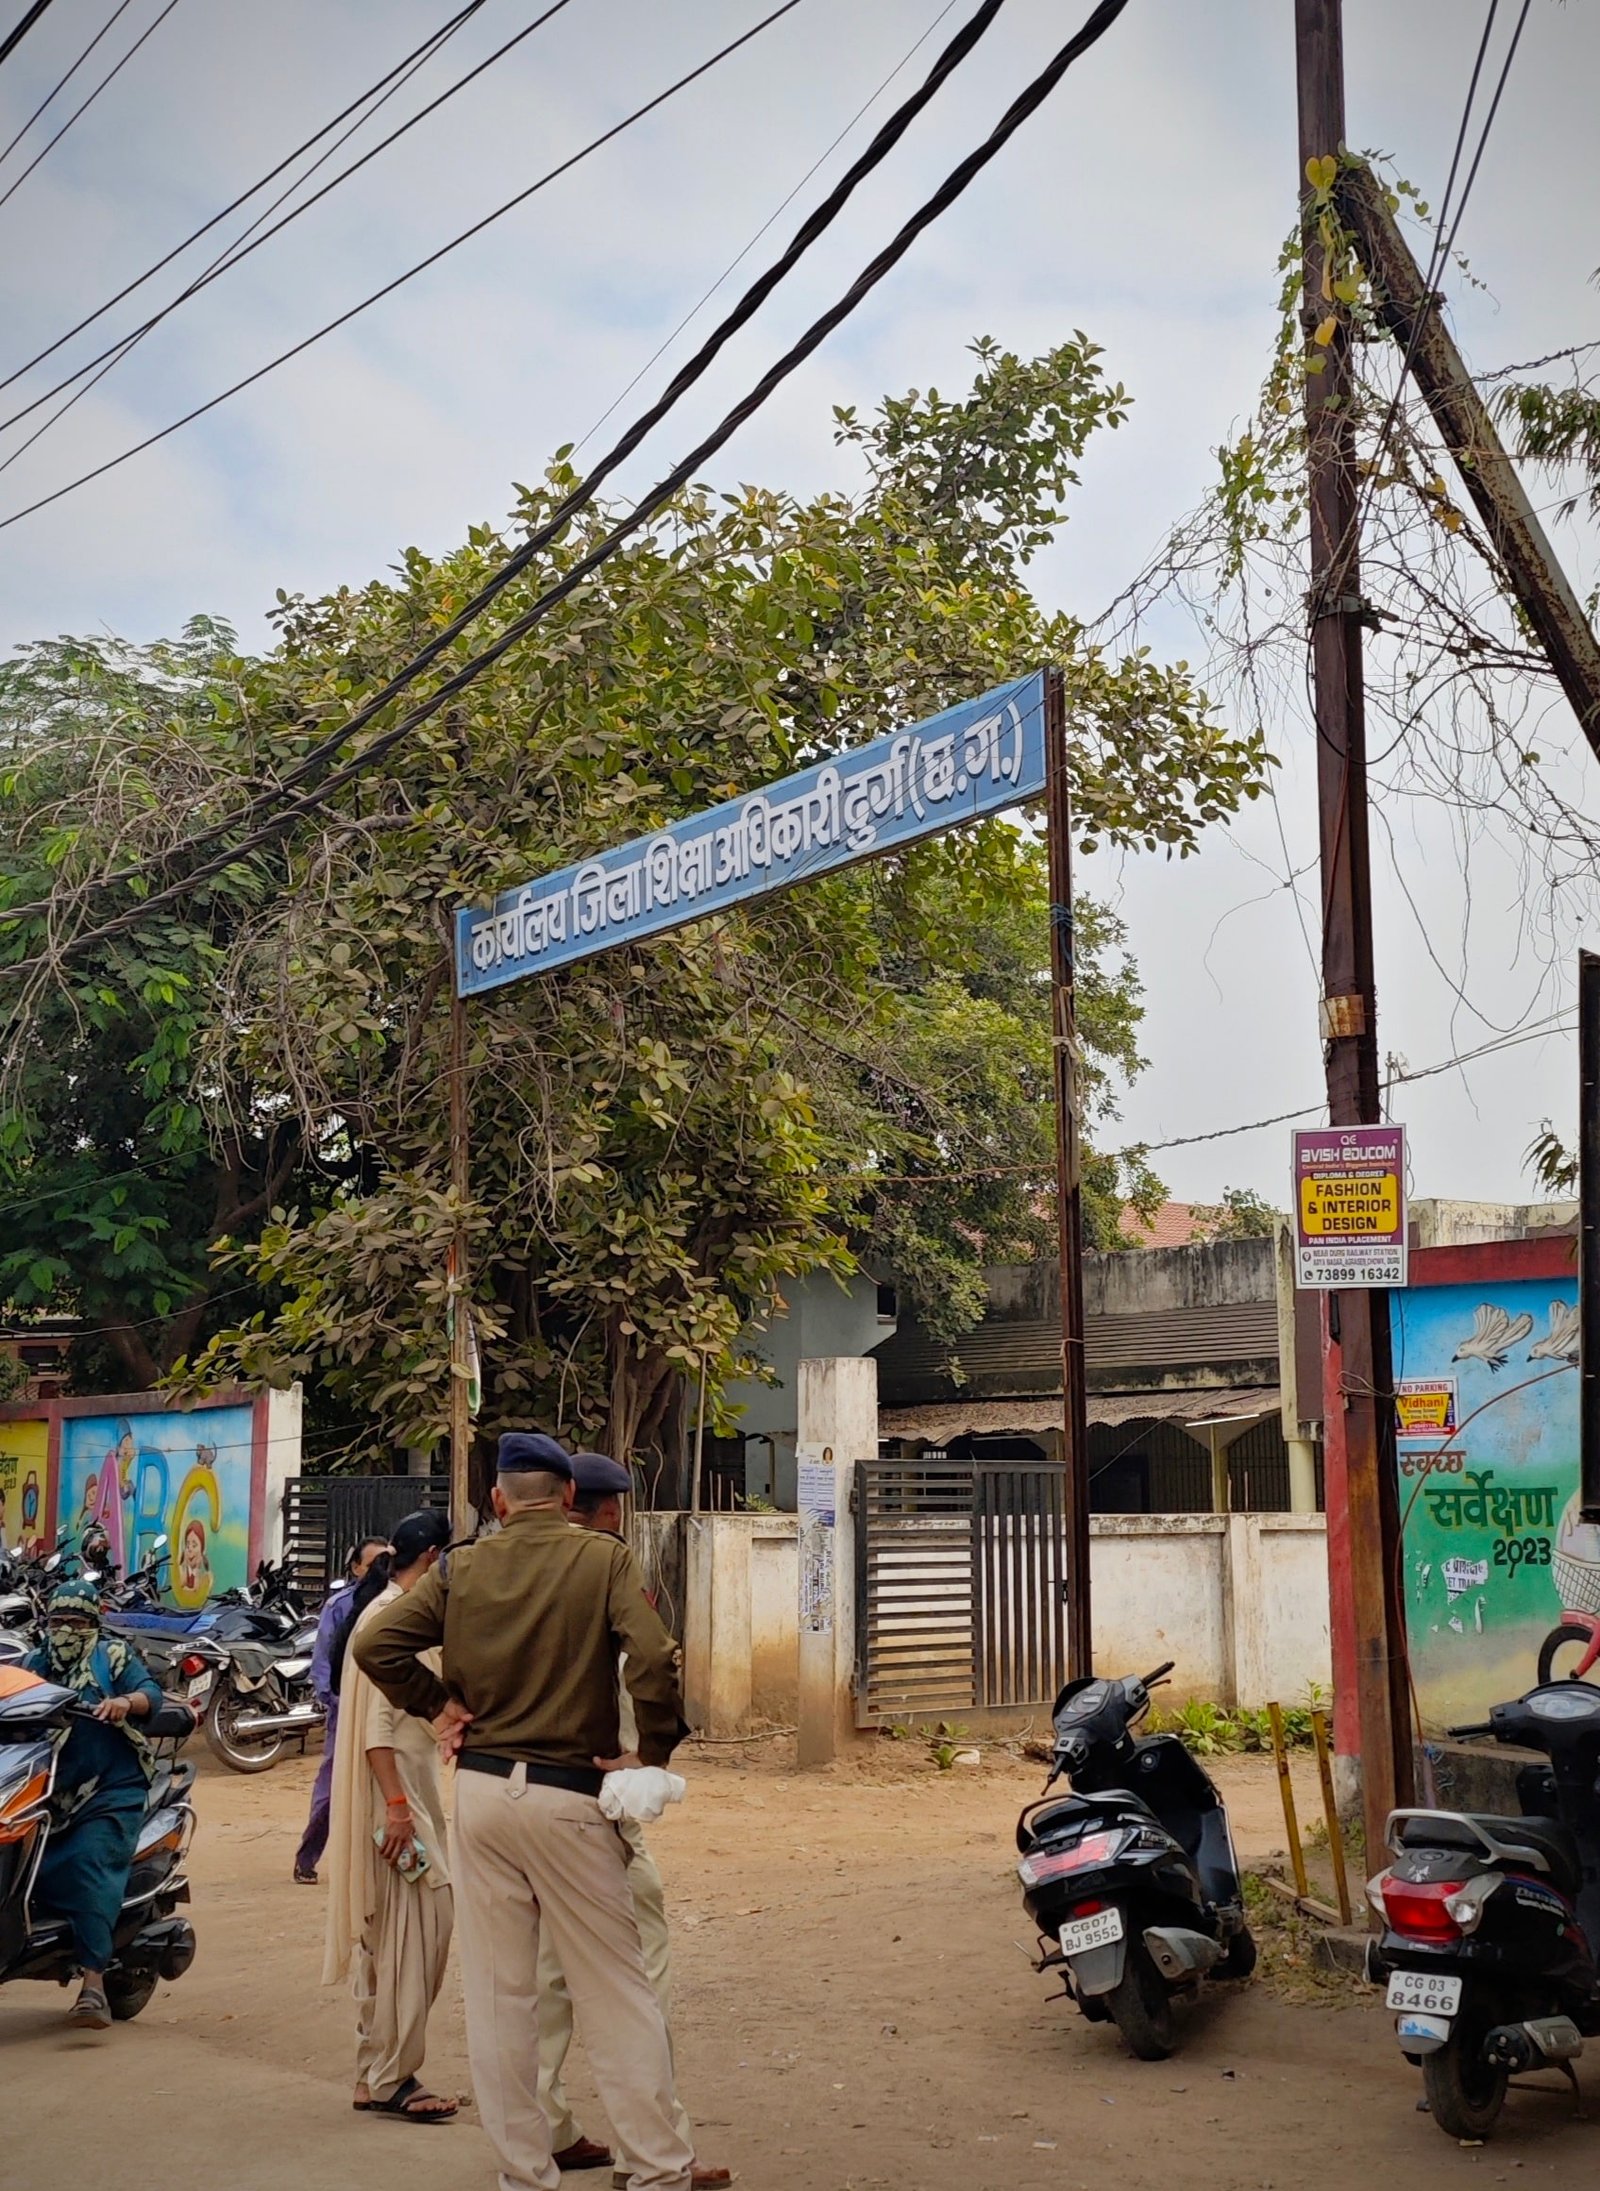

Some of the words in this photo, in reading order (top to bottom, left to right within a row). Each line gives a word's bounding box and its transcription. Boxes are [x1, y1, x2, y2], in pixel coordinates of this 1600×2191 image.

[471, 889, 569, 972] कार्यालय
[571, 858, 641, 934] जिला
[643, 831, 715, 908] शिक्षा
[715, 767, 842, 883] अधिकारी
[1313, 1171, 1347, 1180] DIPLOMA
[1355, 1170, 1385, 1178] DEGREE
[1316, 1182, 1382, 1197] FASHION
[1308, 1201, 1317, 1214] &
[1323, 1199, 1391, 1214] INTERIOR
[1322, 1216, 1377, 1231] DESIGN
[1308, 1237, 1325, 1245] PAN
[1325, 1236, 1347, 1244] INDIA
[1347, 1235, 1392, 1244] PLACEMENT
[1373, 1248, 1398, 1256] STATION
[1316, 1268, 1355, 1280] 73899
[1360, 1267, 1399, 1280] 16342
[1402, 1385, 1413, 1393] NO
[1415, 1383, 1448, 1393] PARKING
[1400, 1396, 1444, 1409] Vidhani
[1424, 1470, 1558, 1536] सर्वेक्षण
[1492, 1537, 1551, 1577] 2023
[1071, 1915, 1108, 1934] CG07
[1065, 1936, 1081, 1951] BJ
[1085, 1925, 1118, 1945] 9552
[1404, 1976, 1424, 1990] CG
[1428, 1979, 1445, 1992] 03
[1391, 1991, 1454, 2011] 8466
